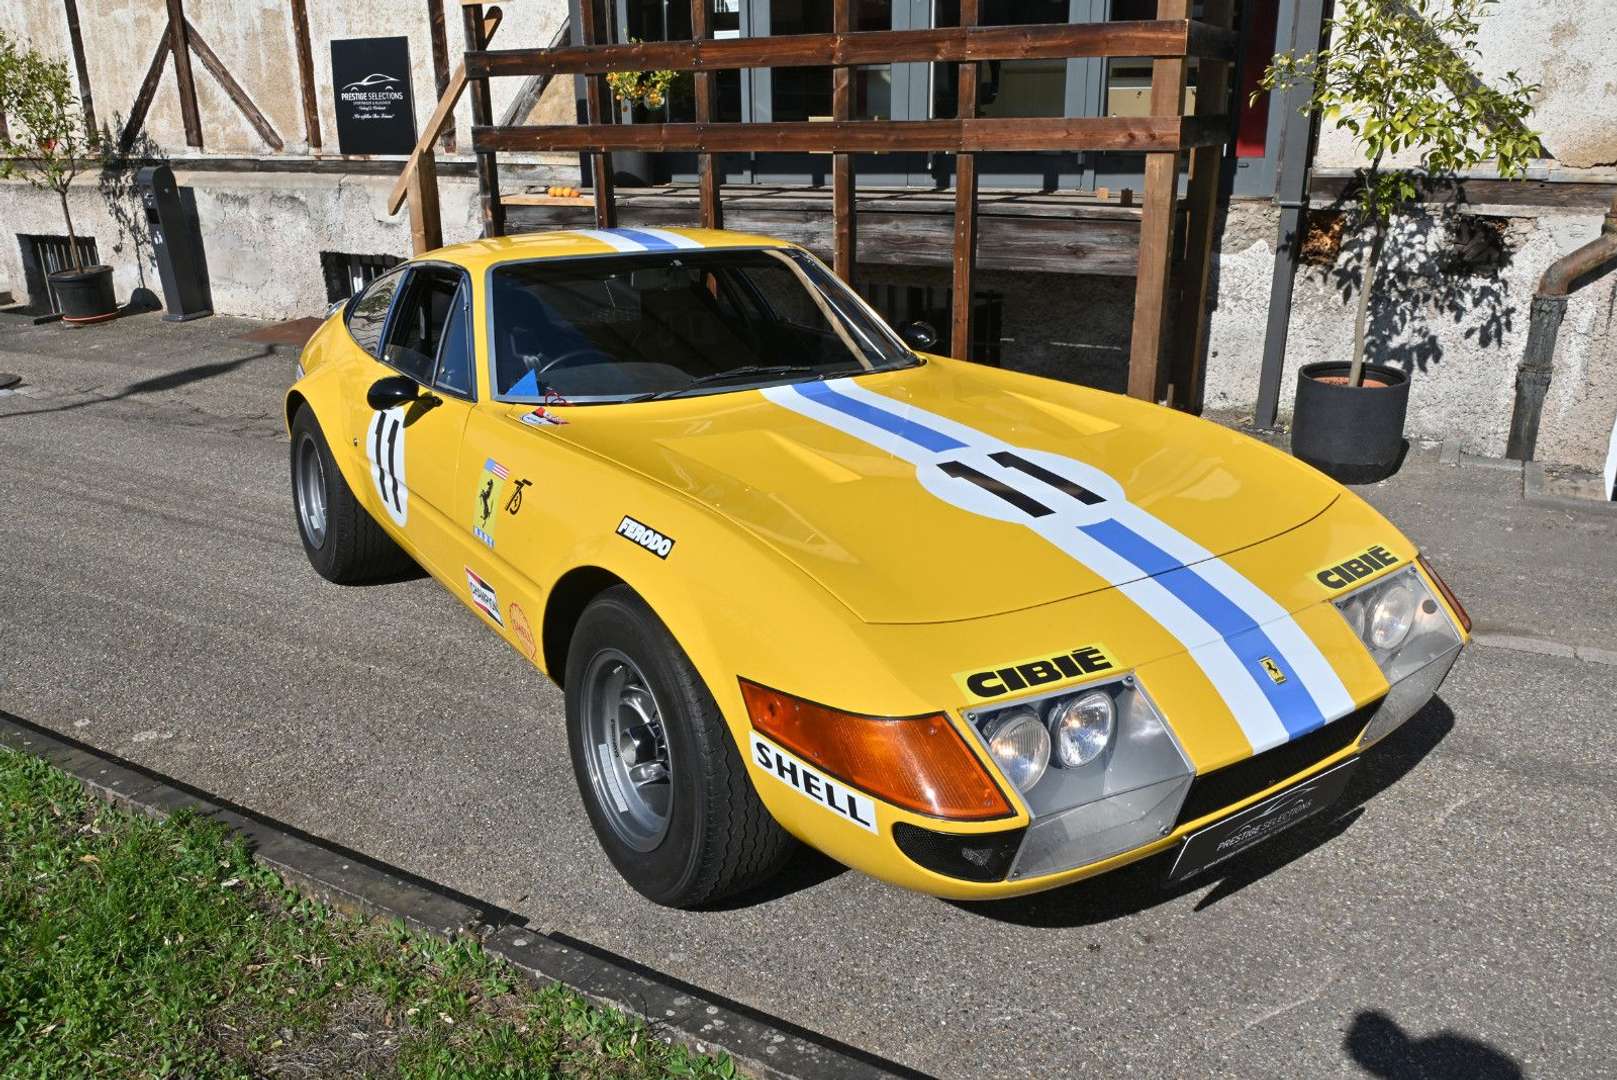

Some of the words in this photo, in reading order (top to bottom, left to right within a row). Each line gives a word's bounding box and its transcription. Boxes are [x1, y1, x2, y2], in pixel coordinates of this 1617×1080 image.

[341, 92, 367, 101] PRESTIGE
[368, 91, 404, 100] SELECTIONS
[375, 410, 402, 514] 11
[935, 451, 1108, 518] 11
[617, 516, 673, 558] FERODO
[755, 741, 871, 827] SHELL
[1216, 824, 1263, 852] PRESTIGE
